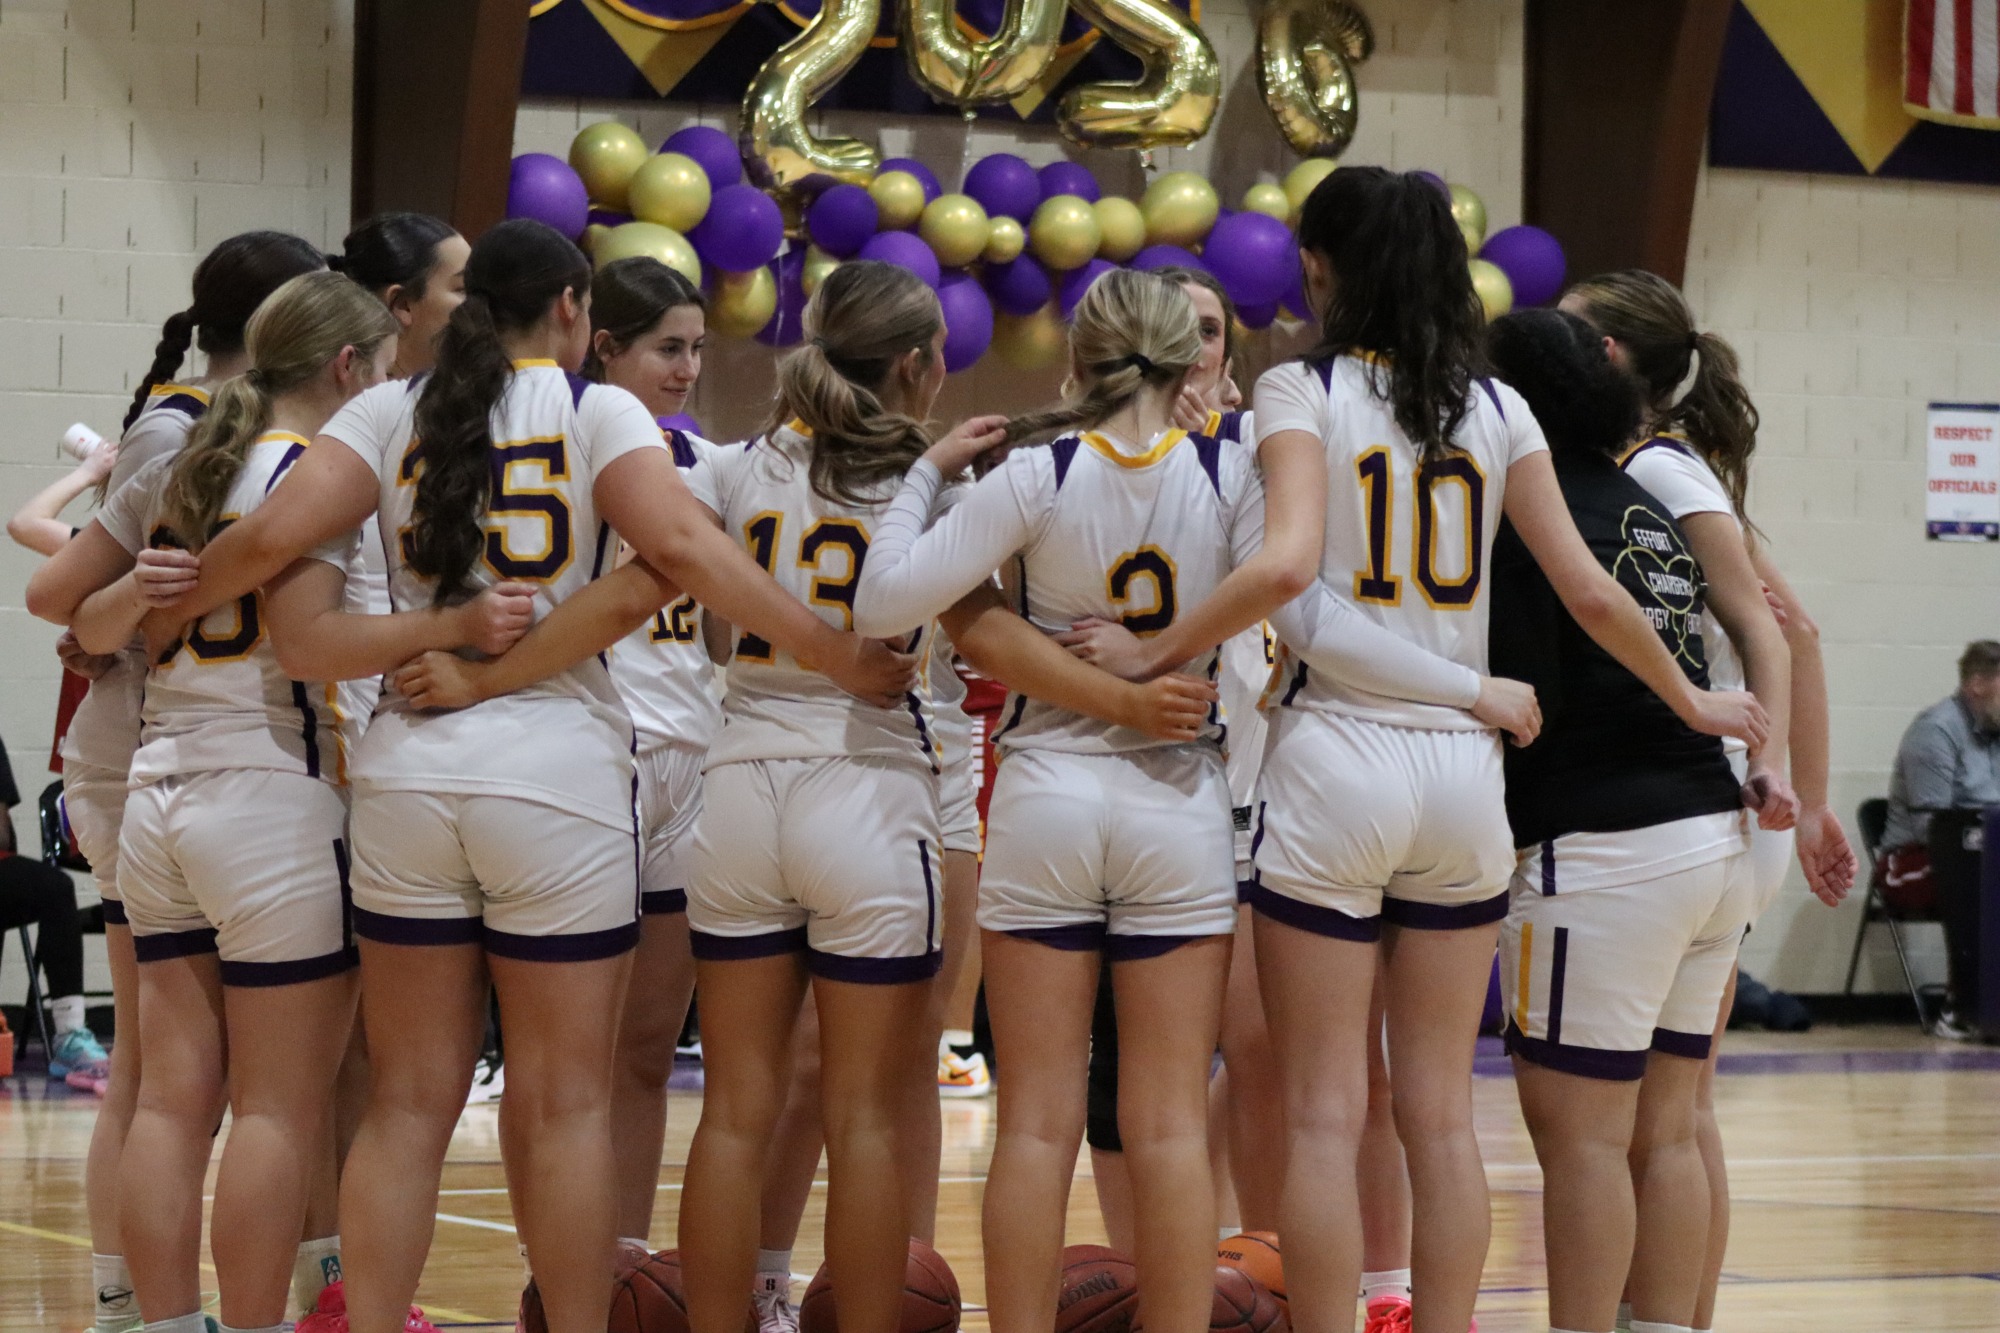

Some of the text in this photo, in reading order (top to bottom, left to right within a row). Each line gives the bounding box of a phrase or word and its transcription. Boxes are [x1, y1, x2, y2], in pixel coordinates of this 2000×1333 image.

[1934, 426, 1993, 441] RESPECT
[1950, 453, 1977, 467] OUR
[1928, 480, 1997, 494] OFFICIALS
[1353, 444, 1487, 611] 10
[1632, 527, 1673, 552] EFFORT
[648, 595, 698, 645] 12
